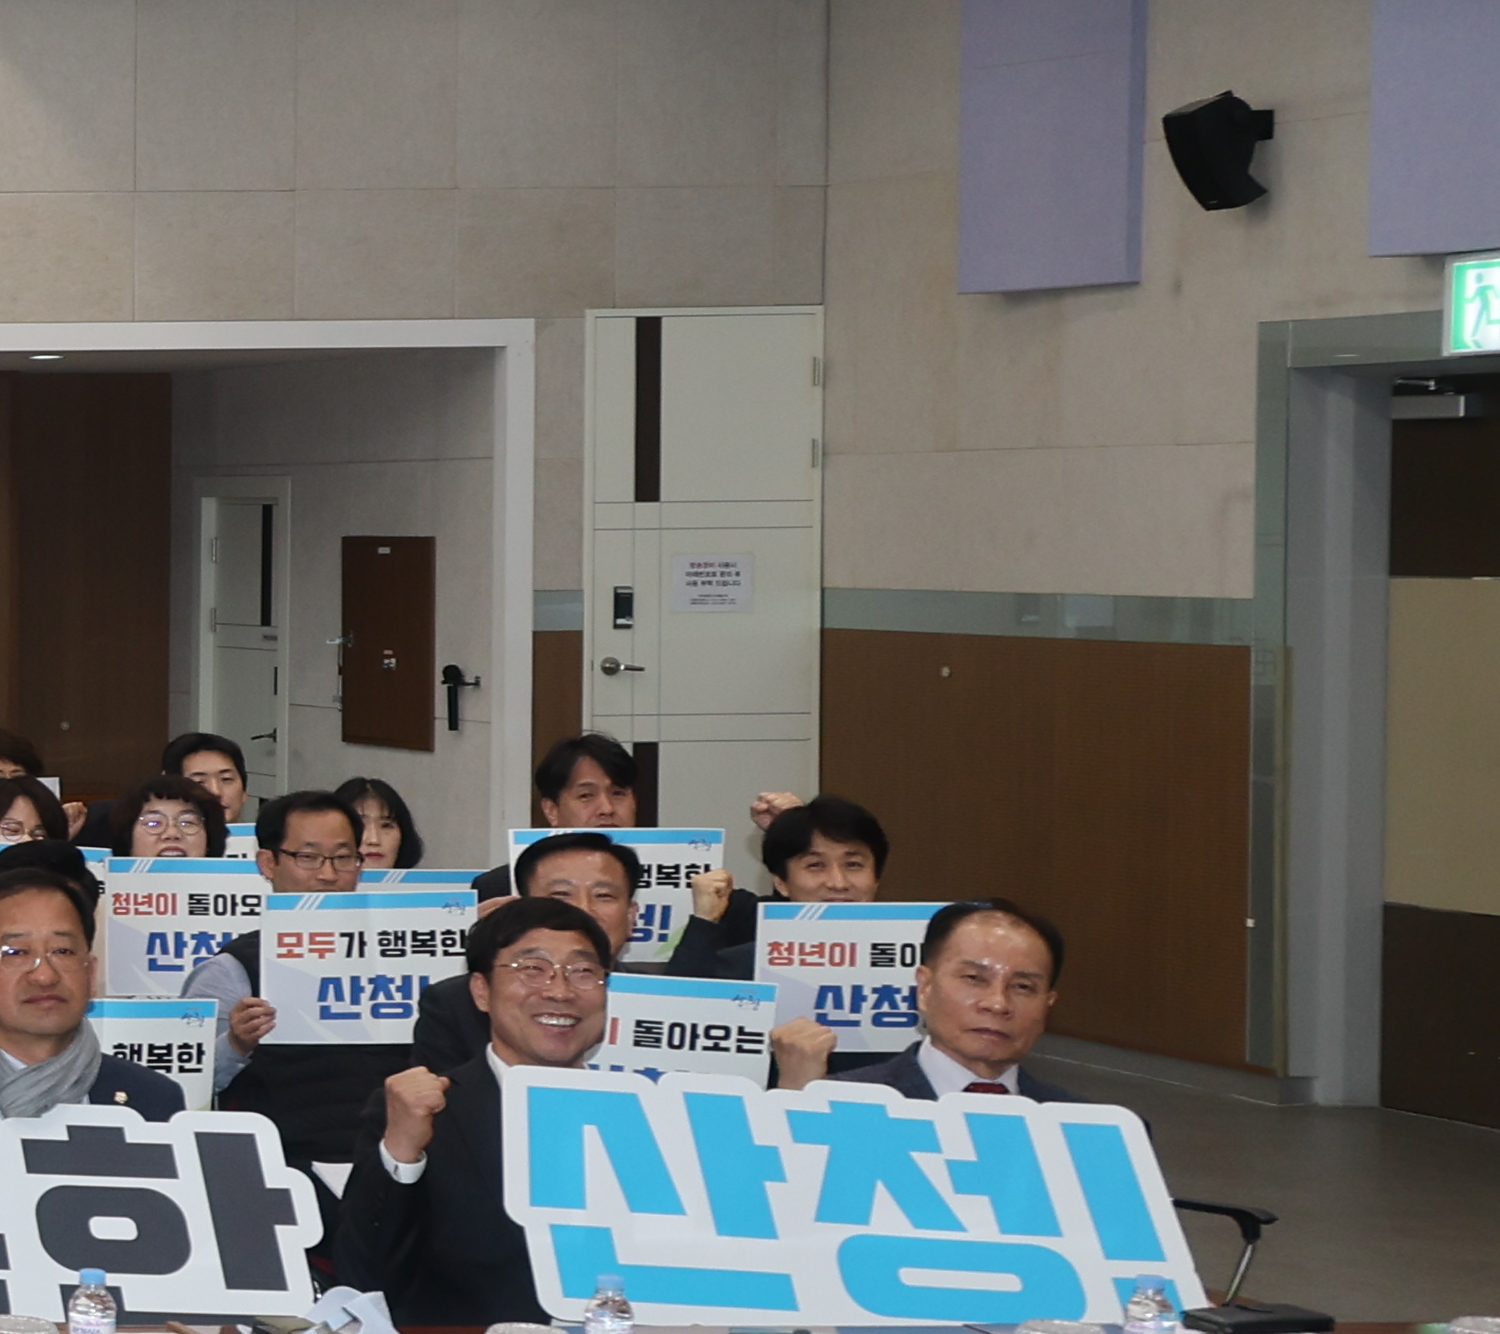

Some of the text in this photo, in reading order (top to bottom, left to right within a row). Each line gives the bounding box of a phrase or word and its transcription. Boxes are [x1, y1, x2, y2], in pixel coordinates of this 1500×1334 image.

[112, 892, 262, 917] 청년이 돌아오
[277, 929, 467, 959] 모두가 행복한
[767, 941, 857, 968] 청년이
[814, 984, 919, 1027] 산청
[633, 1019, 766, 1055] 돌아오는
[527, 1084, 1177, 1324] 산청!
